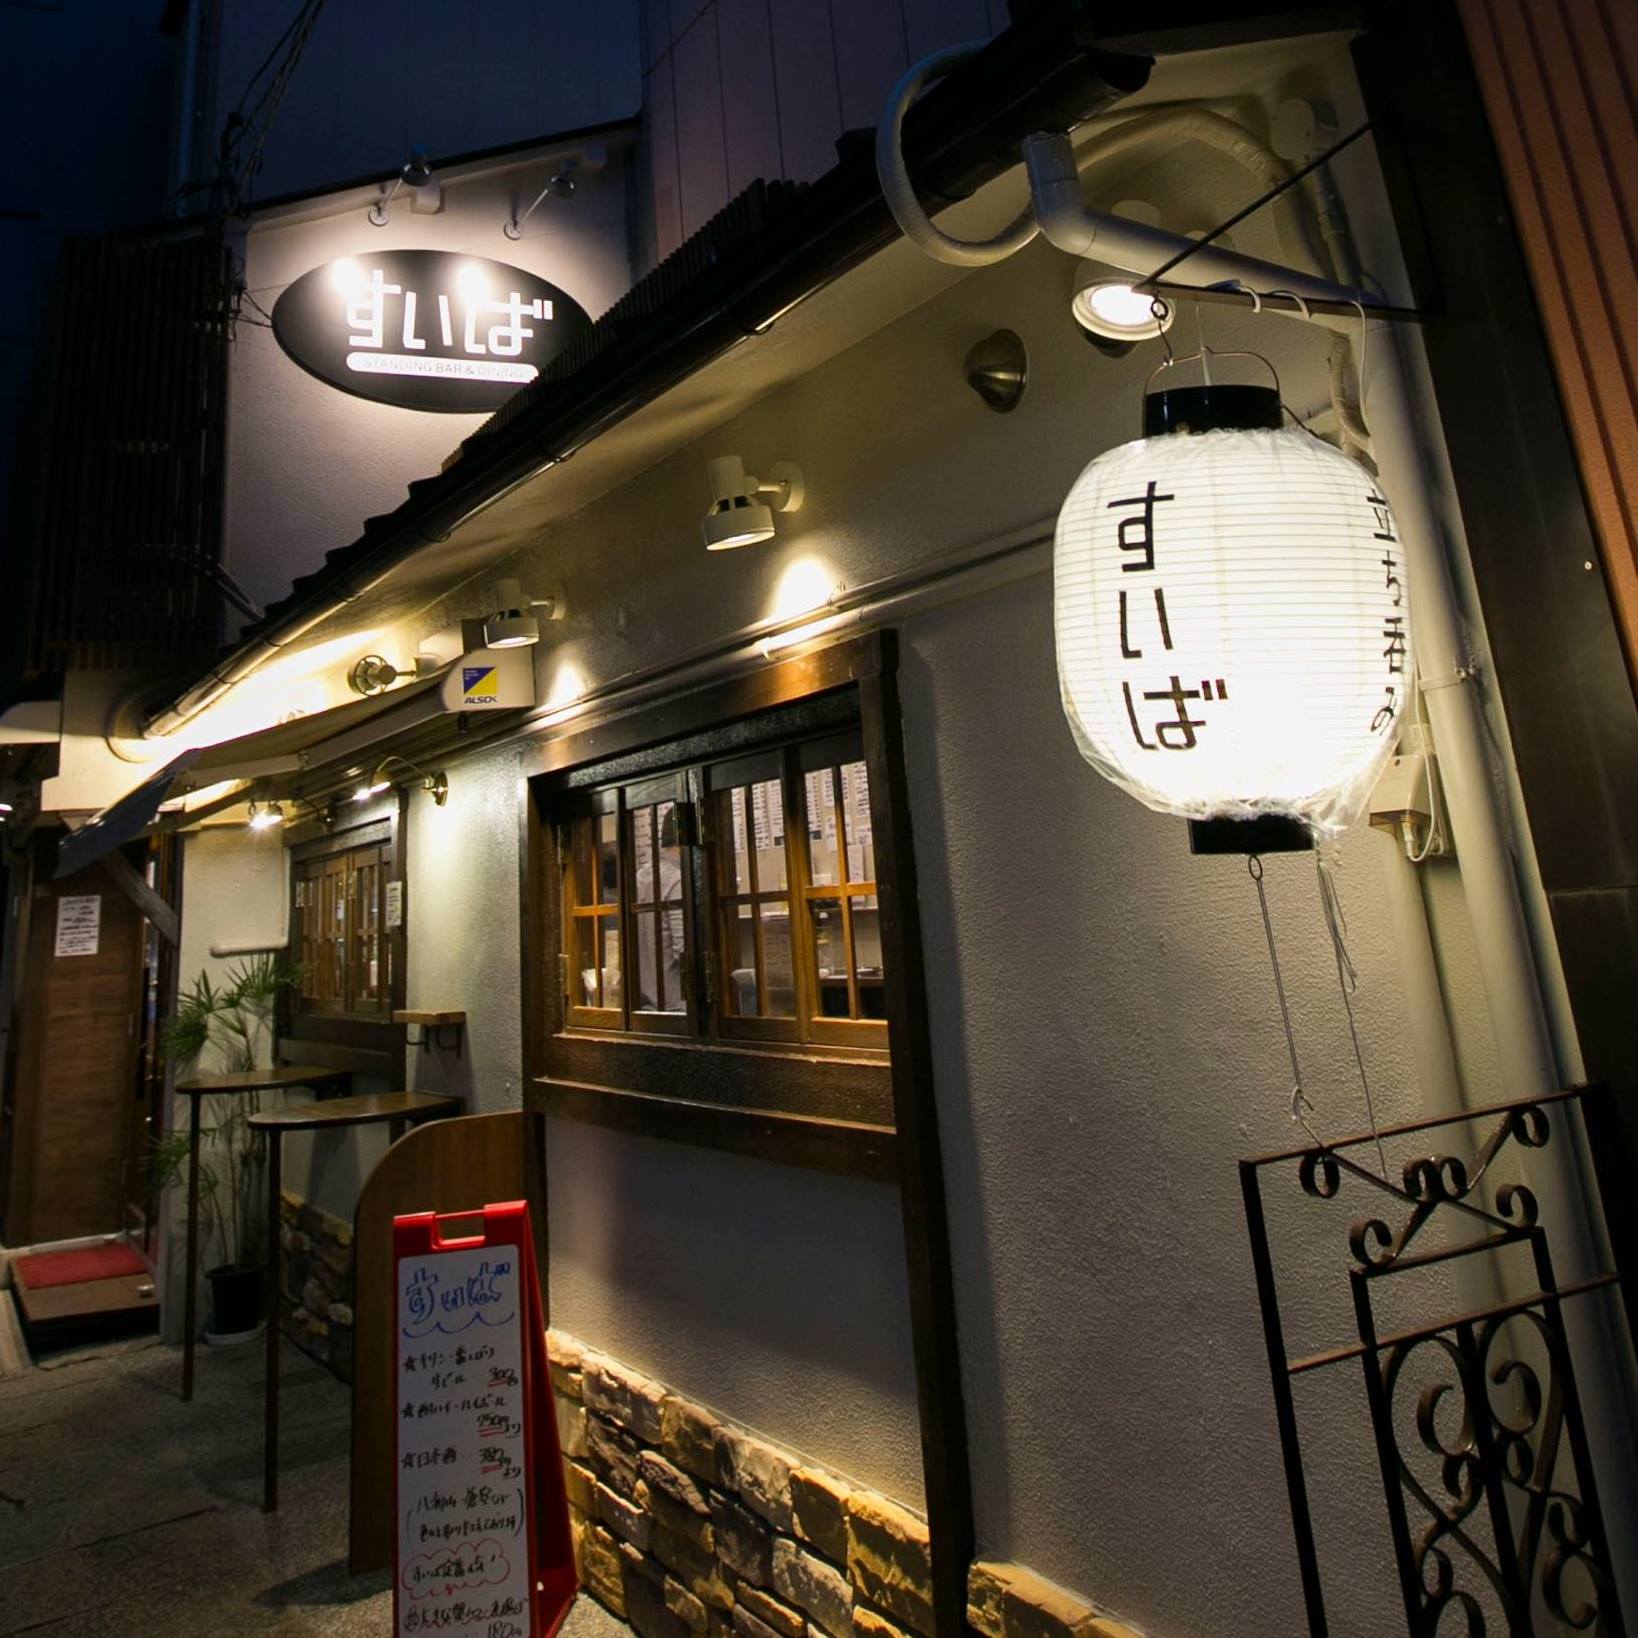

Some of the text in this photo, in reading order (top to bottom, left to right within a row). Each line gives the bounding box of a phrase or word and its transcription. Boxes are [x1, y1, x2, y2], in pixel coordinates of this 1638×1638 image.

[341, 269, 553, 356] すいば
[363, 356, 432, 372] STANDING
[435, 361, 462, 374] BAR
[1107, 481, 1229, 750] すいば
[465, 695, 498, 705] ALSOK
